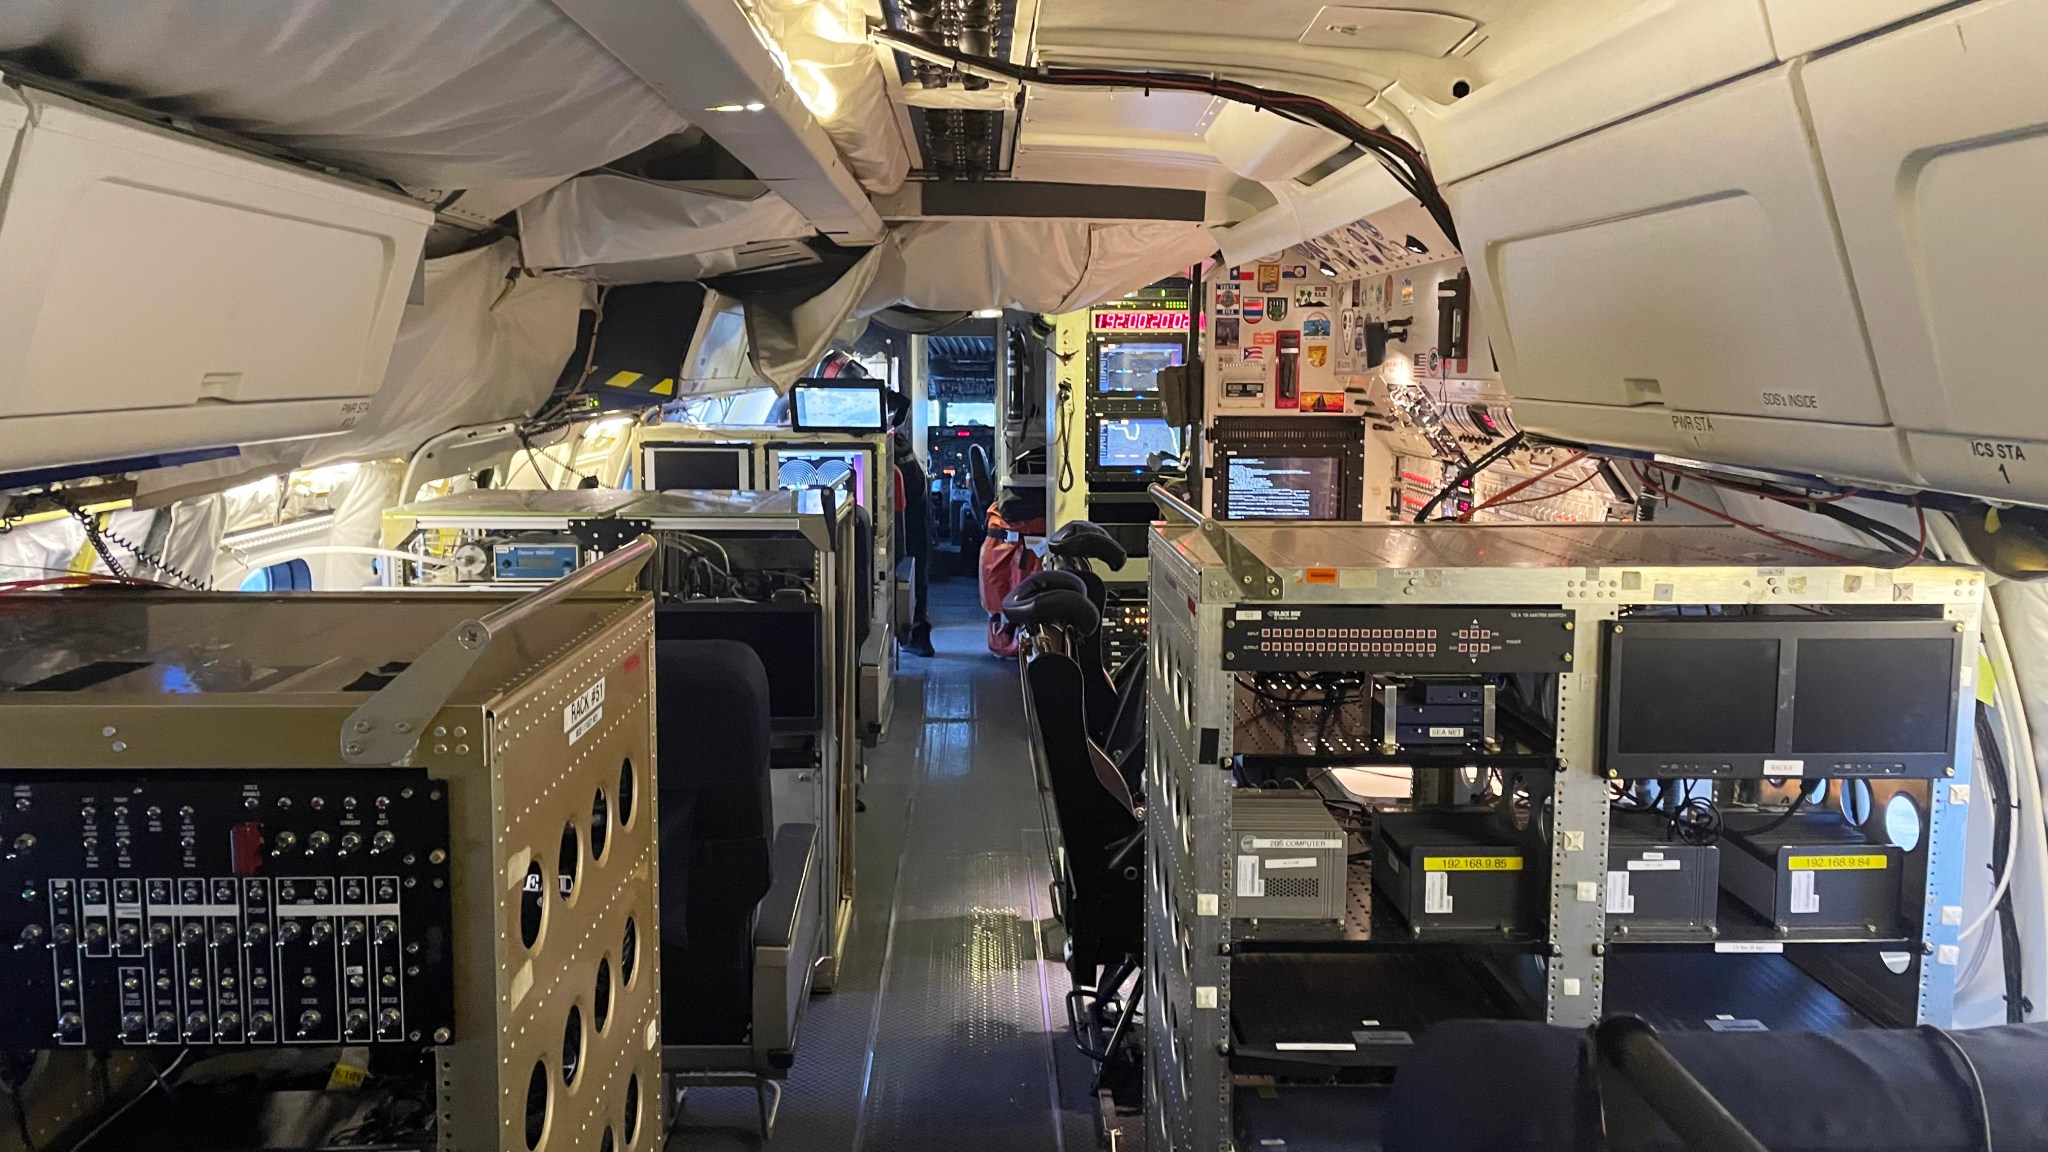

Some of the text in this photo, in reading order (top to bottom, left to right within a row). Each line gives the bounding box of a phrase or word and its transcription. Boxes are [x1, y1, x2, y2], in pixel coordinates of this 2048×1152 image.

[1788, 394, 1818, 409] INSIDE
[1672, 415, 1715, 432] PWR STA
[1971, 441, 2026, 461] ICS STA
[1998, 463, 2010, 484] 1
[571, 682, 604, 724] RACK #51
[1450, 728, 1462, 736] NET
[1285, 840, 1326, 848] COMPUTER
[1442, 859, 1507, 869] 192.168.9.85
[1806, 857, 1870, 868] 192.168.9.84
